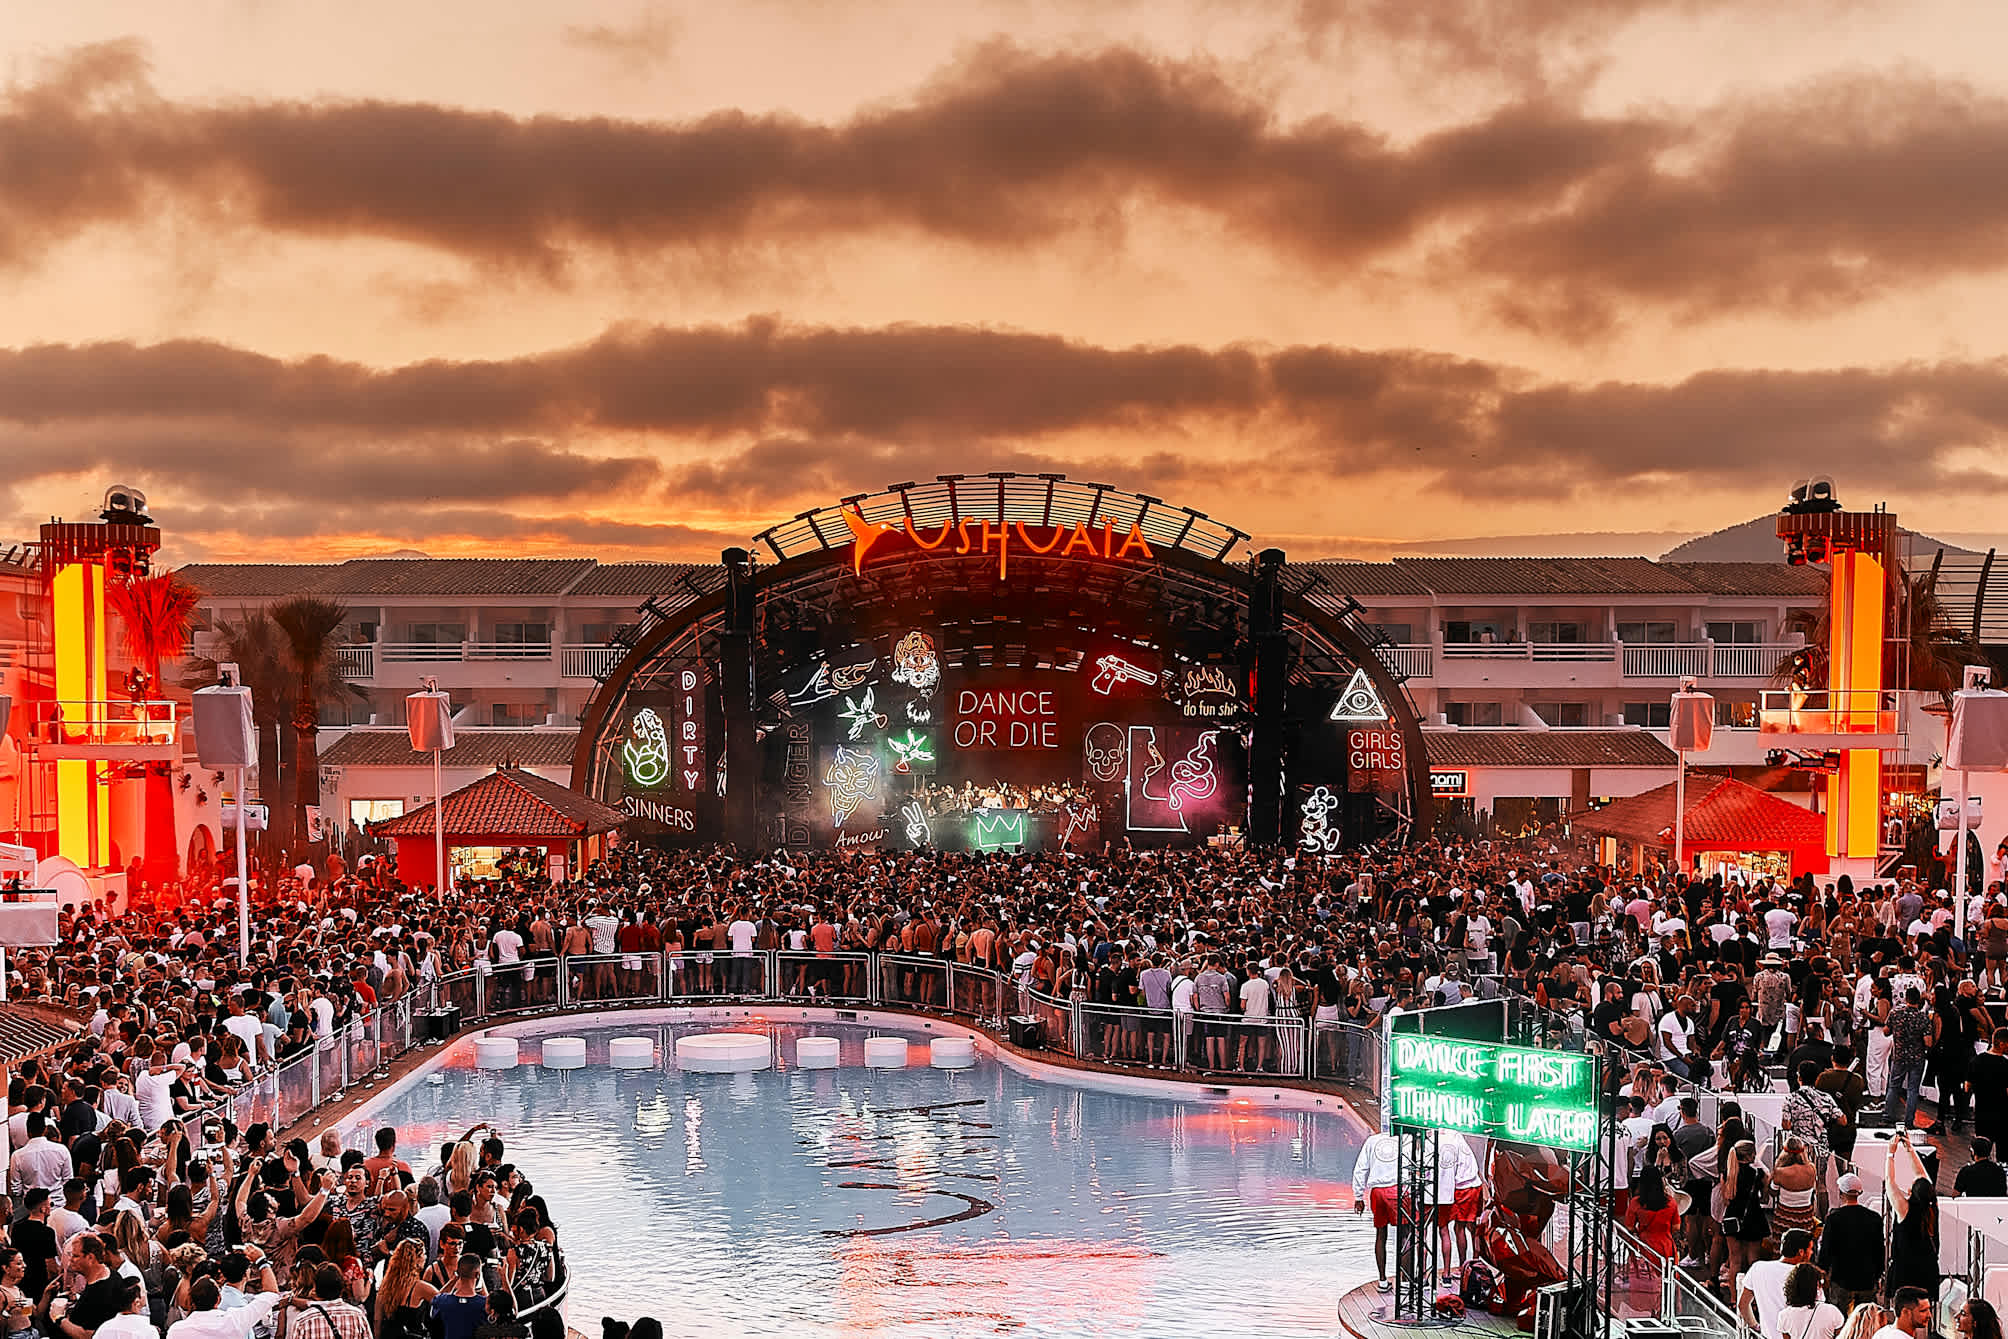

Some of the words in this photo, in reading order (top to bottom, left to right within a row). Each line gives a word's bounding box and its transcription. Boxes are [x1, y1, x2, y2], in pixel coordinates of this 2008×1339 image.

[959, 690, 1055, 715] DANCE
[1183, 700, 1197, 716] do
[1199, 700, 1216, 716] fun
[1218, 701, 1239, 716] shit
[682, 670, 699, 790] DIRTY
[955, 720, 997, 748] OR
[1010, 721, 1059, 748] DIE
[1350, 731, 1402, 750] GIRLS
[1350, 751, 1402, 770] GIRLS
[788, 723, 810, 846] DANGER
[624, 796, 695, 831] SINNERS
[834, 829, 890, 848] Amour
[1397, 1038, 1494, 1079] DANCE
[1498, 1051, 1584, 1089] FIRST
[1507, 1102, 1597, 1145] LATER
